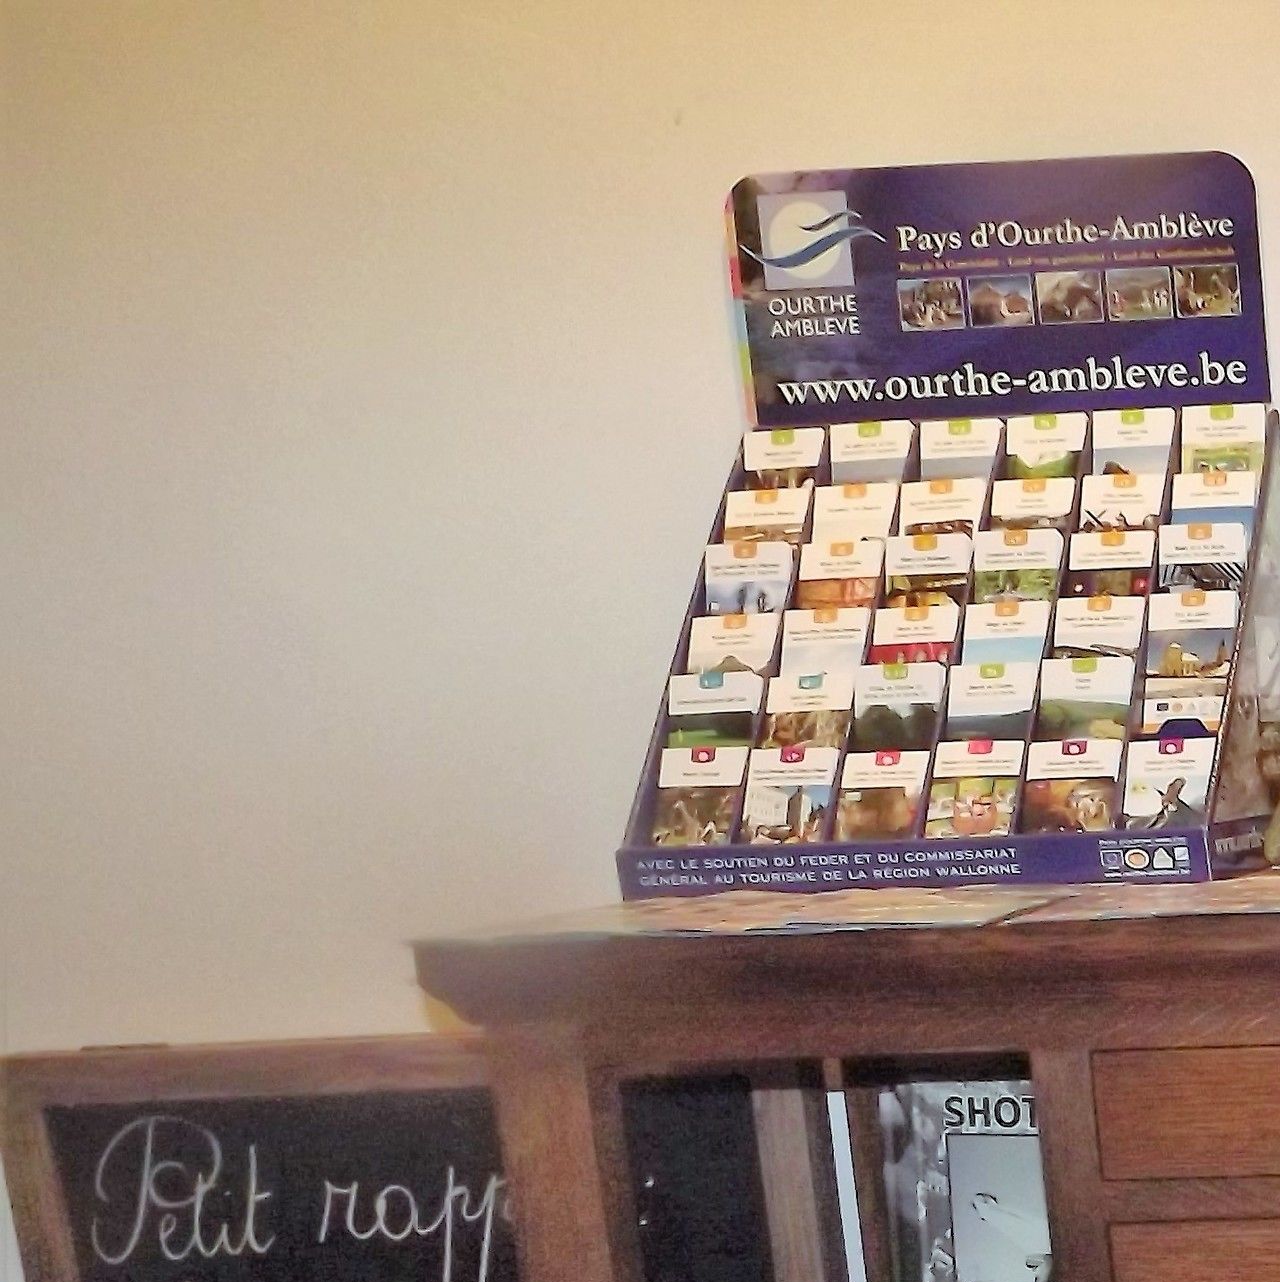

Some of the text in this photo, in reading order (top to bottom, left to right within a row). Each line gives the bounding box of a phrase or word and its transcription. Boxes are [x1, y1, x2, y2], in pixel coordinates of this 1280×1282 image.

[896, 225, 962, 258] Pays
[768, 295, 858, 316] OURTHE
[777, 352, 1248, 406] www.ourthe-ambleve.be
[637, 847, 1017, 870] AVEC LE SOUTIEN DU FEDER ET DU COMMISSARIAT
[715, 874, 735, 884] AU
[740, 871, 817, 884] TOURISME
[822, 870, 842, 881] DE
[848, 869, 867, 880] LA
[936, 863, 1021, 878] WALLONNE
[92, 1115, 277, 1265] Petit
